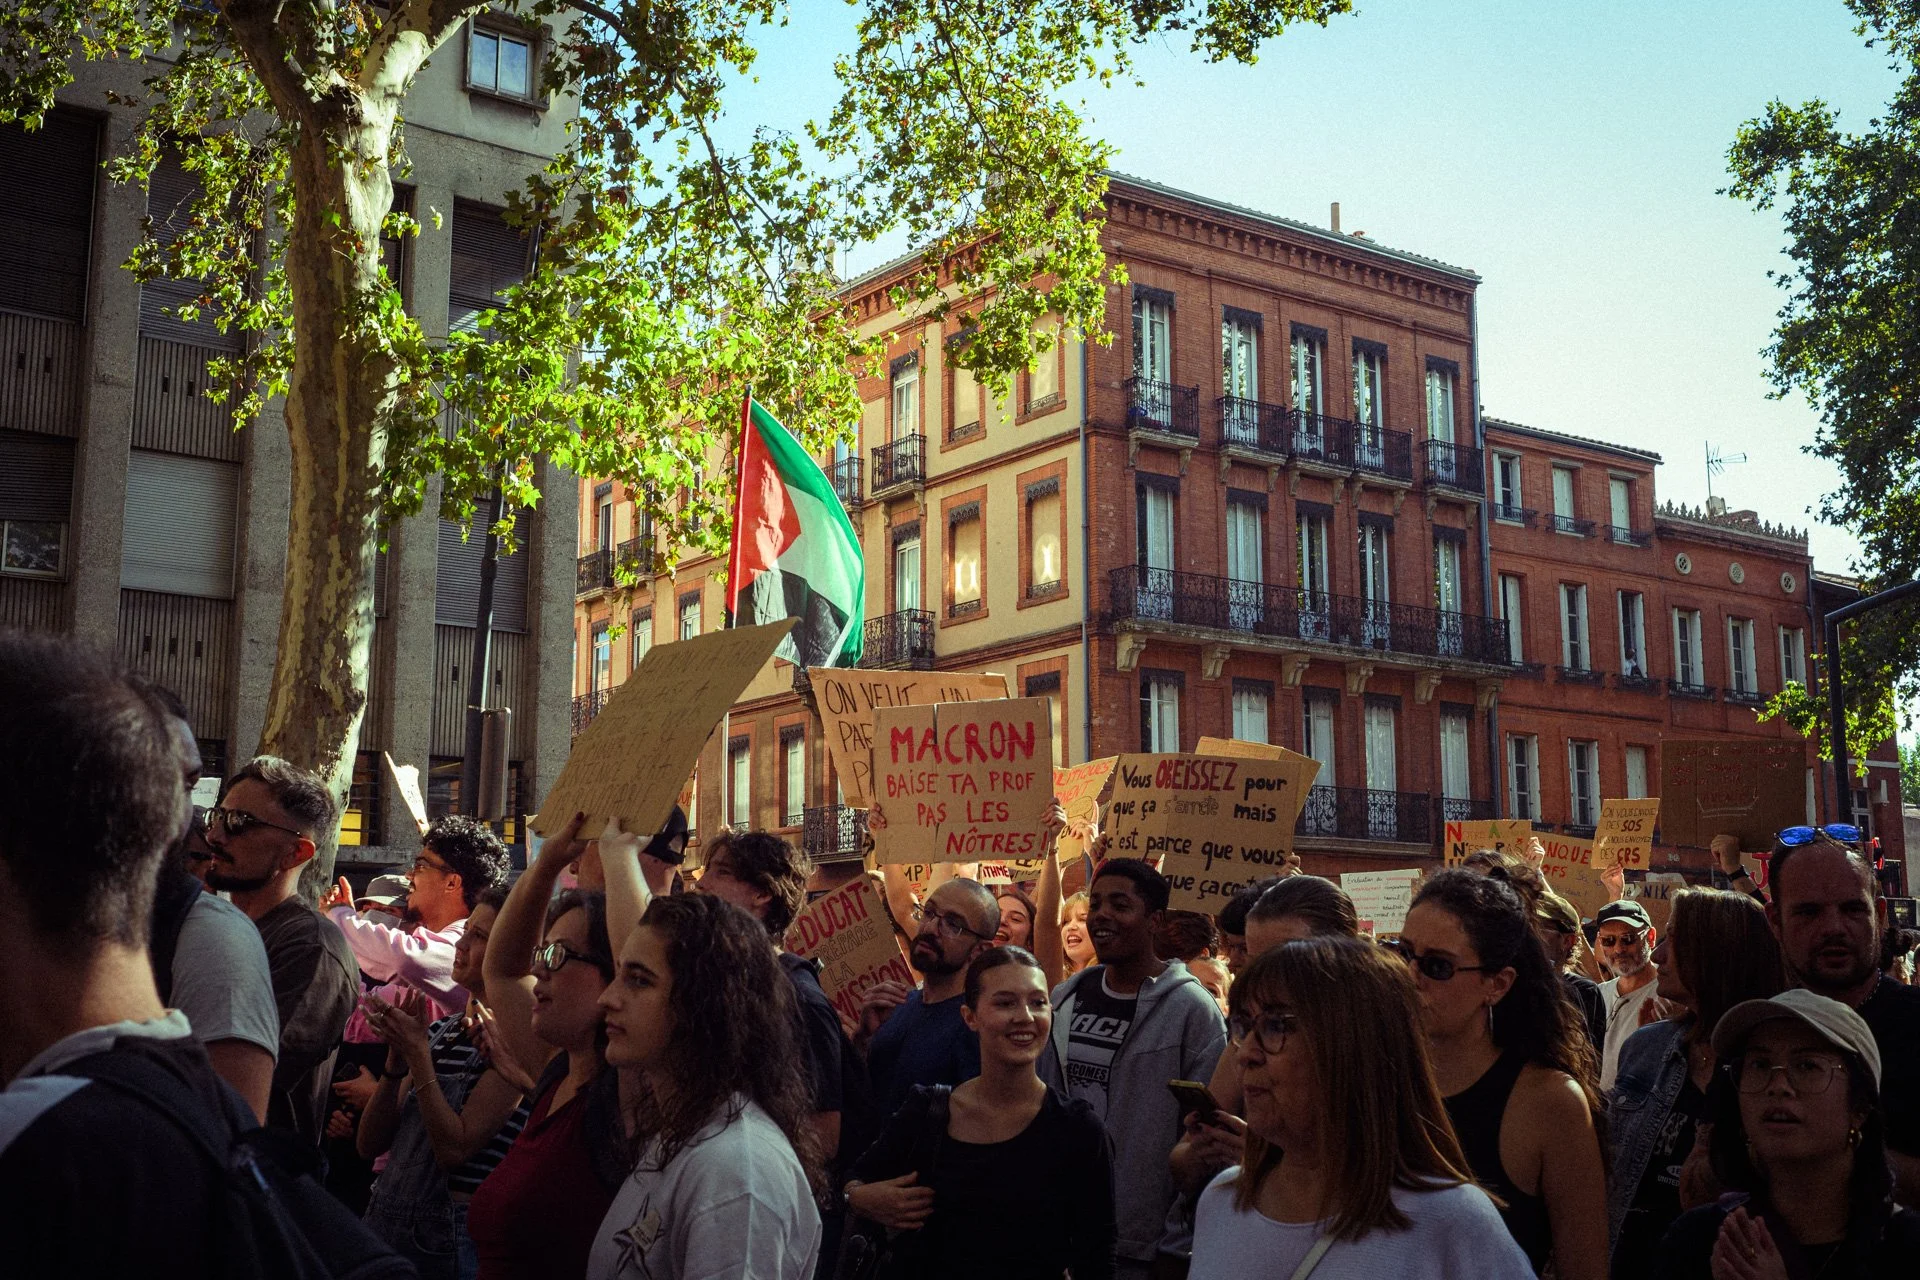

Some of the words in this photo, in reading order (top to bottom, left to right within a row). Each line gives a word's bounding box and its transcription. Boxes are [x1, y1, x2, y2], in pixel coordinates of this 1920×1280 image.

[825, 679, 857, 714] ON
[890, 720, 1035, 765] MACRON
[947, 773, 977, 795] TA
[989, 771, 1035, 793] PROF
[1122, 764, 1152, 789] Vous
[1245, 776, 1287, 800] pour
[917, 802, 946, 827] PAS
[967, 801, 1008, 823] LES
[1113, 801, 1135, 828] que
[1142, 800, 1157, 820] ça
[1233, 803, 1277, 822] mais
[1603, 807, 1614, 817] ON
[1606, 820, 1619, 830] DES
[1621, 819, 1643, 832] SOS
[1142, 836, 1192, 862] parce
[1201, 841, 1233, 871] que
[1240, 846, 1286, 865] vous
[1601, 848, 1614, 859] DES
[828, 961, 855, 986] LA
[1067, 1063, 1107, 1080] ECOMES
